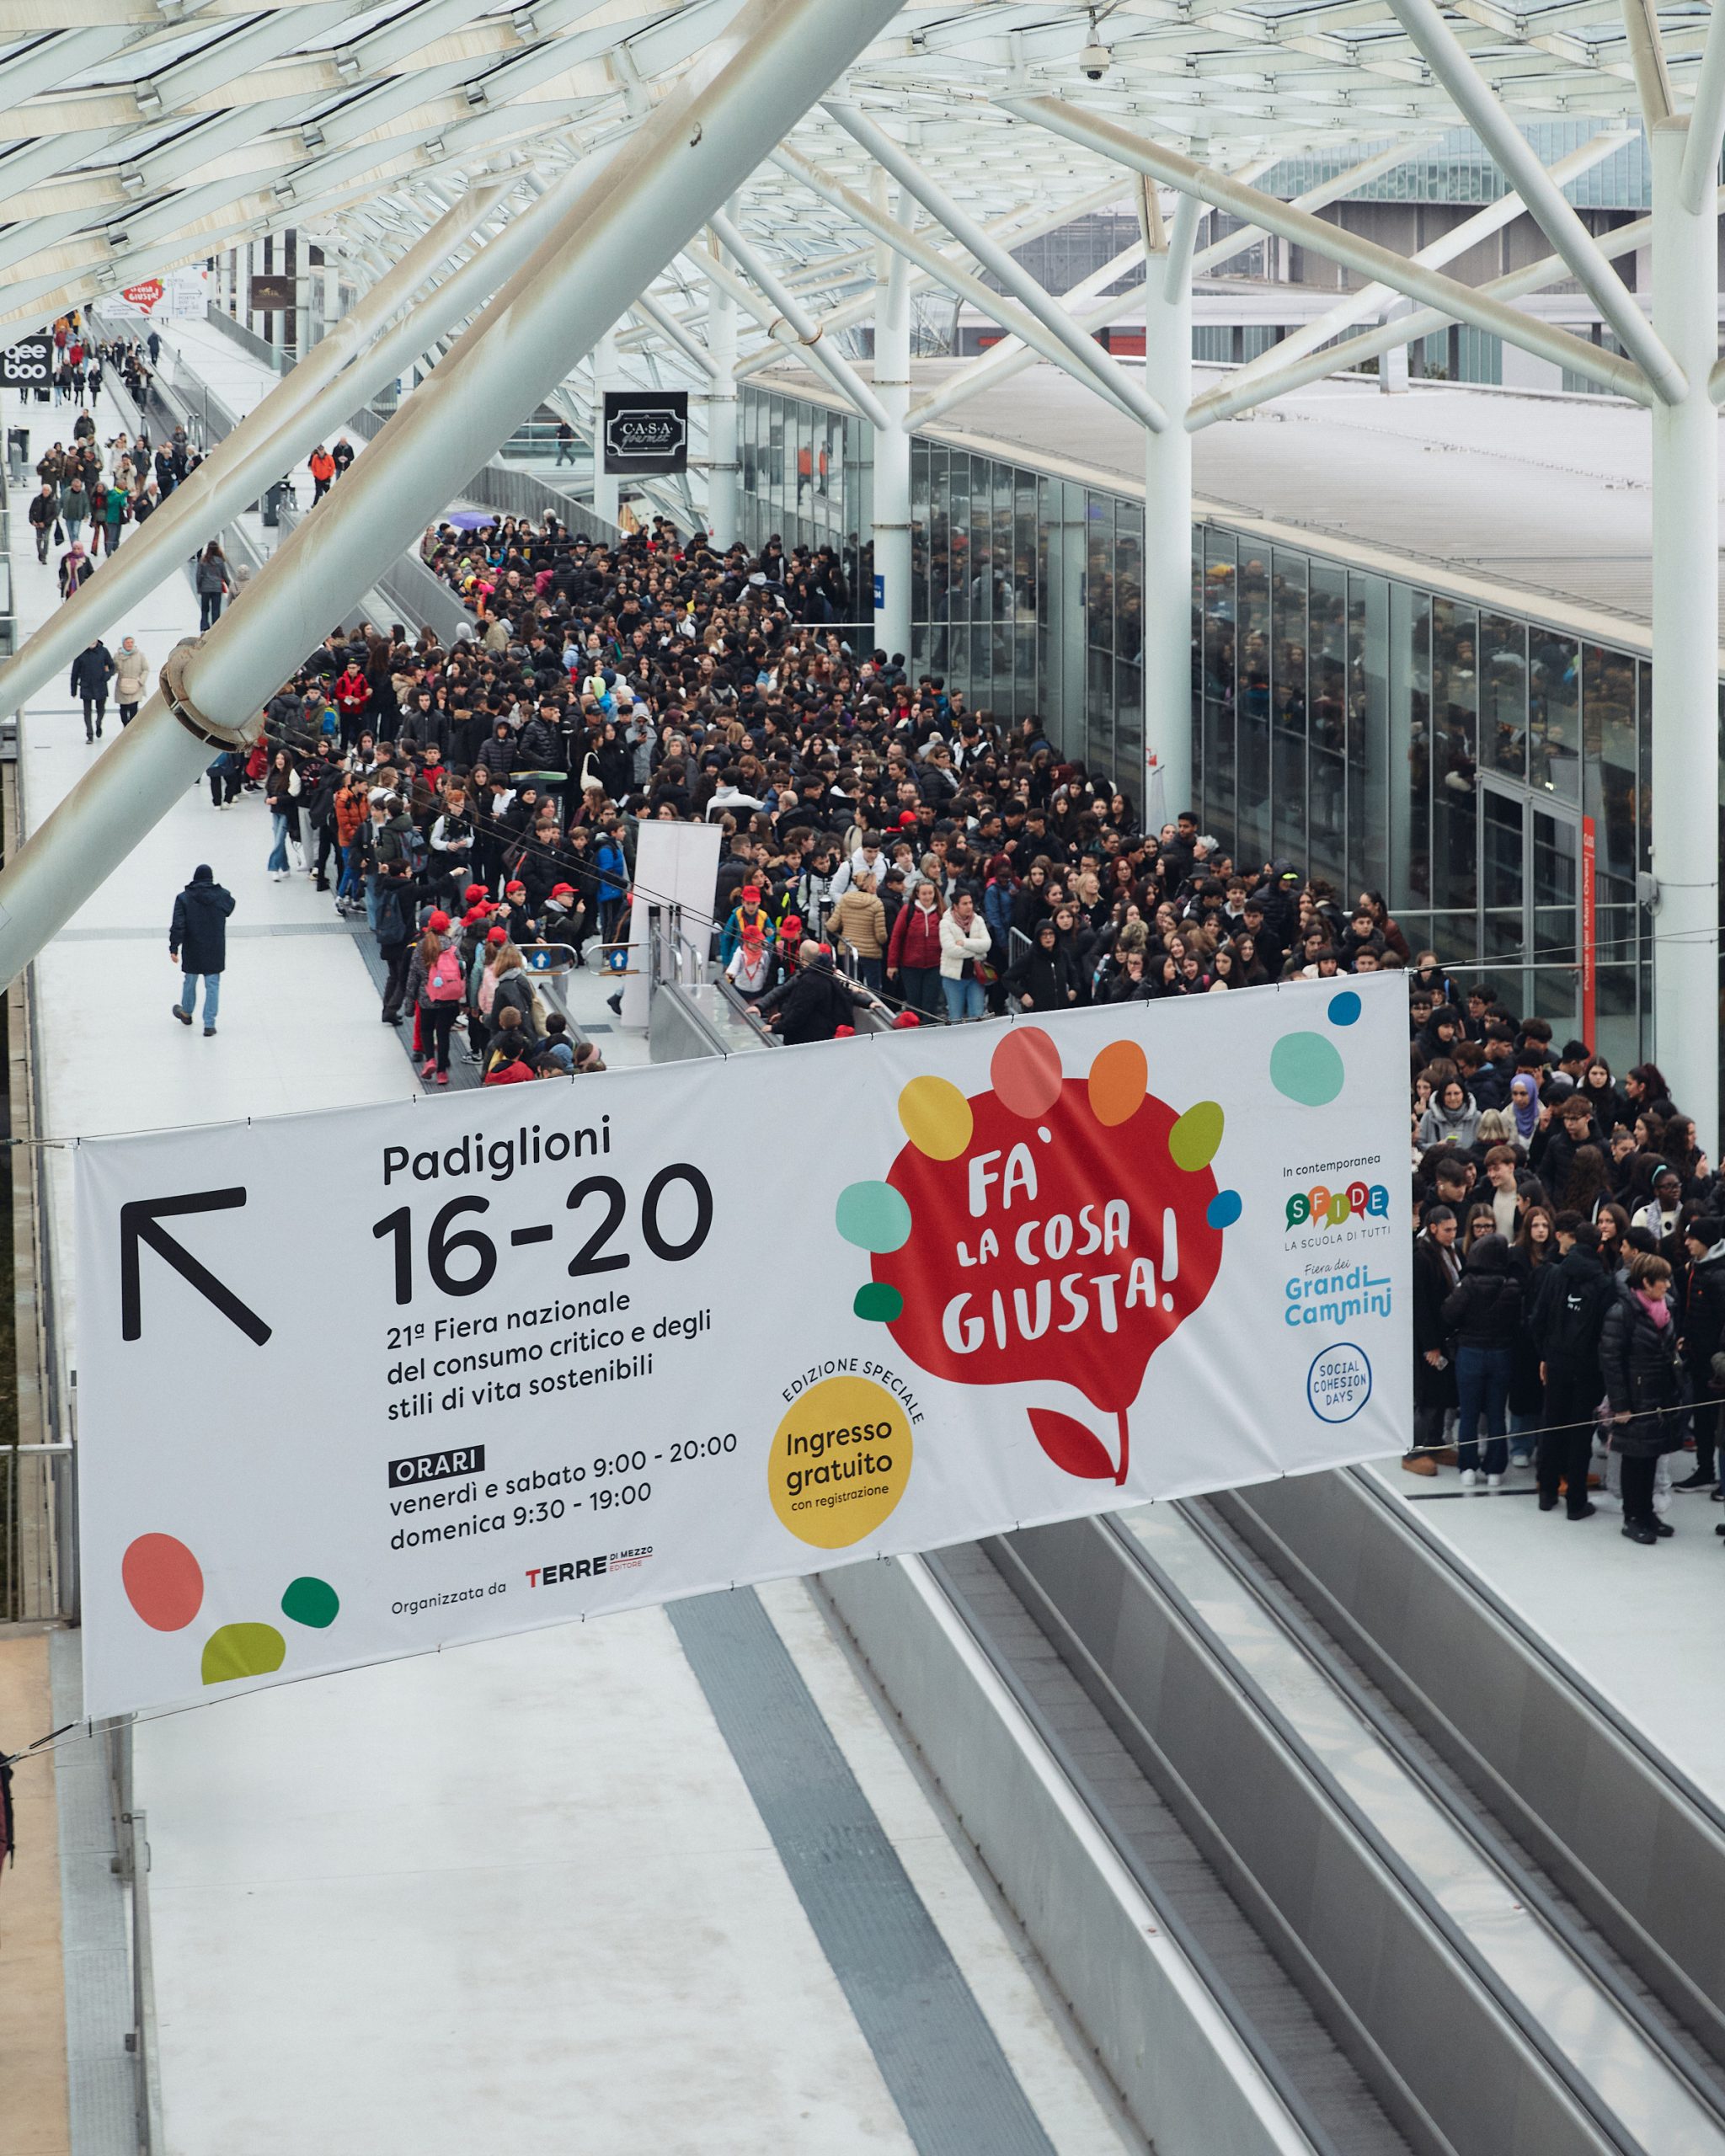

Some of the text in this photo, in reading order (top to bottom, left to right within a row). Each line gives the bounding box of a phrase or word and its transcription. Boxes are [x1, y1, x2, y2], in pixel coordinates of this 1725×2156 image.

[128, 287, 158, 302] GIUSTA!
[3, 359, 47, 379] boo
[384, 1115, 610, 1185] Padiglioni
[1284, 1155, 1380, 1177] In contemporanea
[1292, 1187, 1383, 1219] SFIDE
[373, 1163, 713, 1305] 16-20
[957, 1199, 1130, 1267] LA COSA
[1285, 1226, 1390, 1251] LA SCUOLA DI TUTTI
[942, 1207, 1178, 1354] GIUSTA!
[1285, 1265, 1391, 1300] Grandi
[1305, 1258, 1351, 1276] Fiera dei
[435, 1317, 497, 1342] Fiera
[508, 1291, 630, 1333] nazionale
[387, 1309, 710, 1385] del consumo critico e degli
[388, 1353, 652, 1420] stili di vita sostenibili
[1314, 1375, 1365, 1393] COHESION
[1320, 1363, 1359, 1376] SOCIAL
[782, 1358, 923, 1424] EDIZIONE SPECIALE
[1327, 1390, 1353, 1406] DAYS
[788, 1422, 892, 1458] Ingresso
[390, 1482, 477, 1518] venerdì
[486, 1484, 498, 1497] e
[506, 1466, 585, 1494] sabato
[594, 1451, 645, 1477] 9:00
[670, 1433, 736, 1462] 20:00
[397, 1449, 475, 1481] ORARI
[787, 1452, 892, 1499] gratuito
[792, 1486, 889, 1511] con registrazione
[391, 1515, 505, 1550] domenica
[514, 1499, 564, 1526] 9:30
[590, 1483, 650, 1510] 19:00
[393, 1588, 483, 1614] Organizzata
[489, 1582, 505, 1594] da
[526, 1555, 607, 1588] TERRE
[621, 1546, 653, 1557] MEZZO
[609, 1560, 643, 1572] EDITORE
